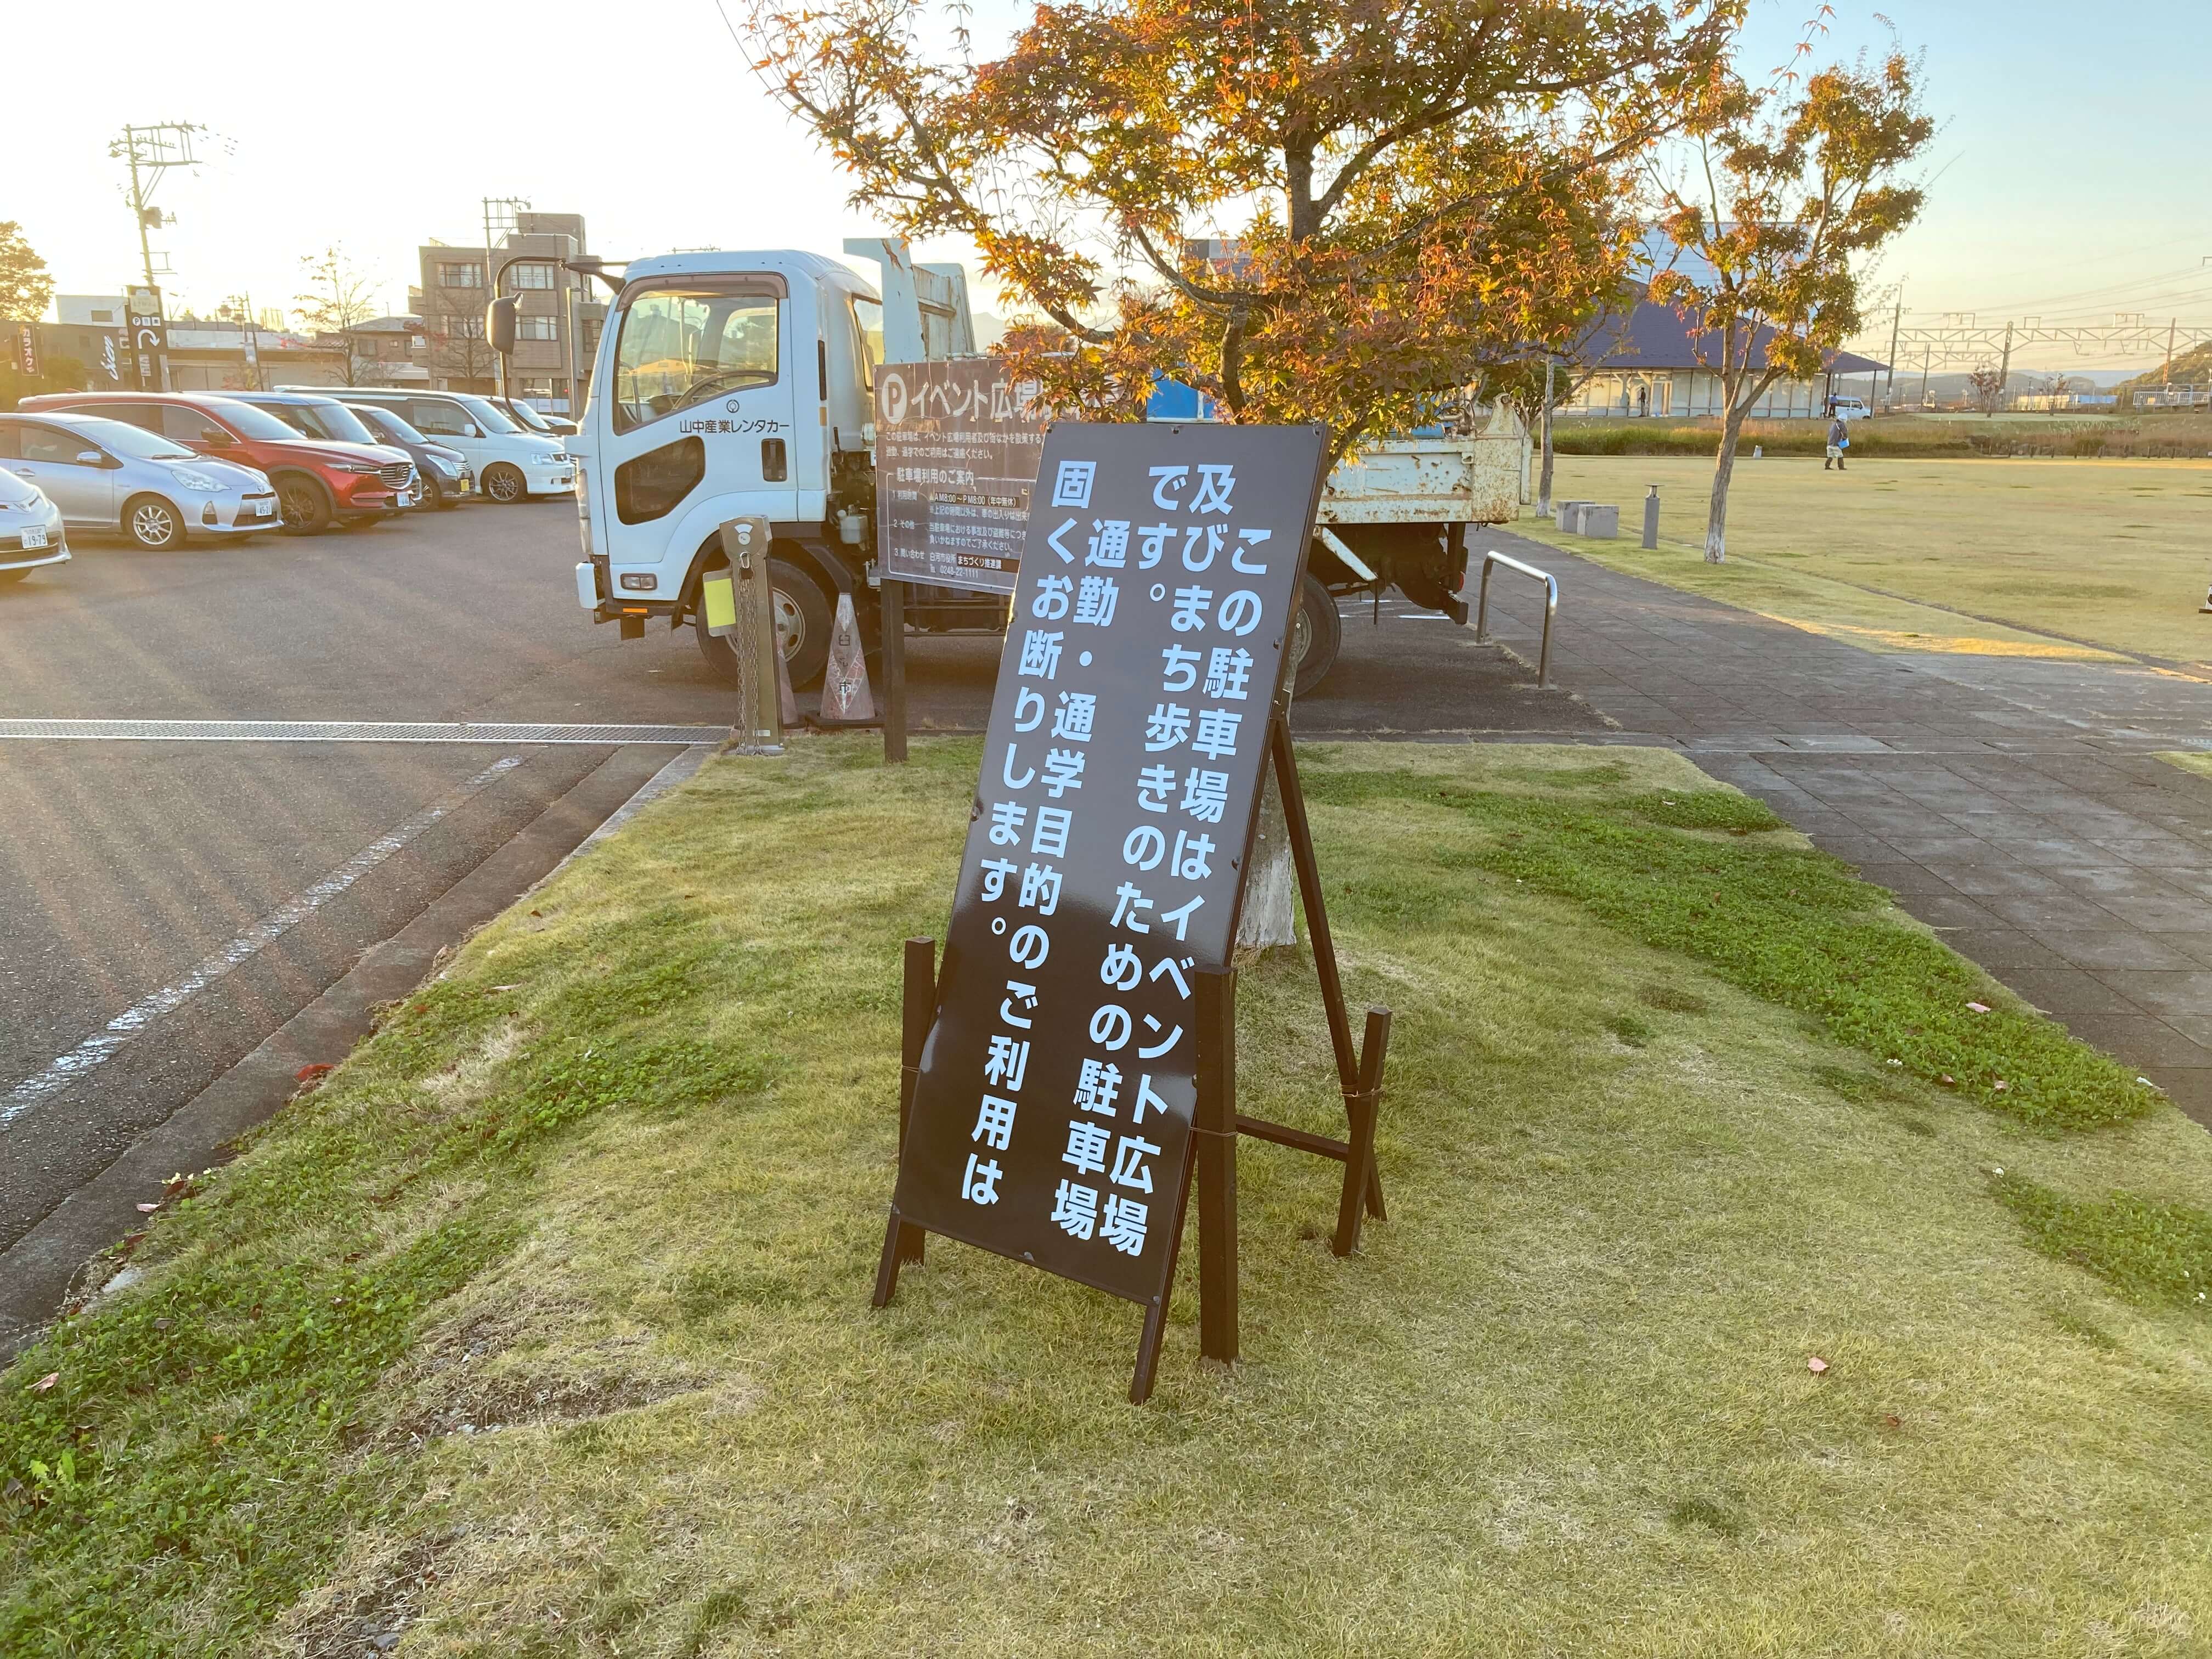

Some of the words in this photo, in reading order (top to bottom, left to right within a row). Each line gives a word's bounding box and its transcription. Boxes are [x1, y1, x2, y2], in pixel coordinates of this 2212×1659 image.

[680, 420, 790, 433] 山中産業レンタカー
[897, 467, 974, 486] 駐車場利用のご案内
[911, 377, 1052, 424] イベント広場
[1137, 465, 1189, 603] です。
[980, 460, 1097, 936] 固くお断りします。
[961, 518, 1131, 1206] 通勤・通学目的のご利用は
[1050, 464, 1236, 1241] 及びまち歩きのための駐車場
[1099, 527, 1272, 1257] この駐車場はイベント広場
